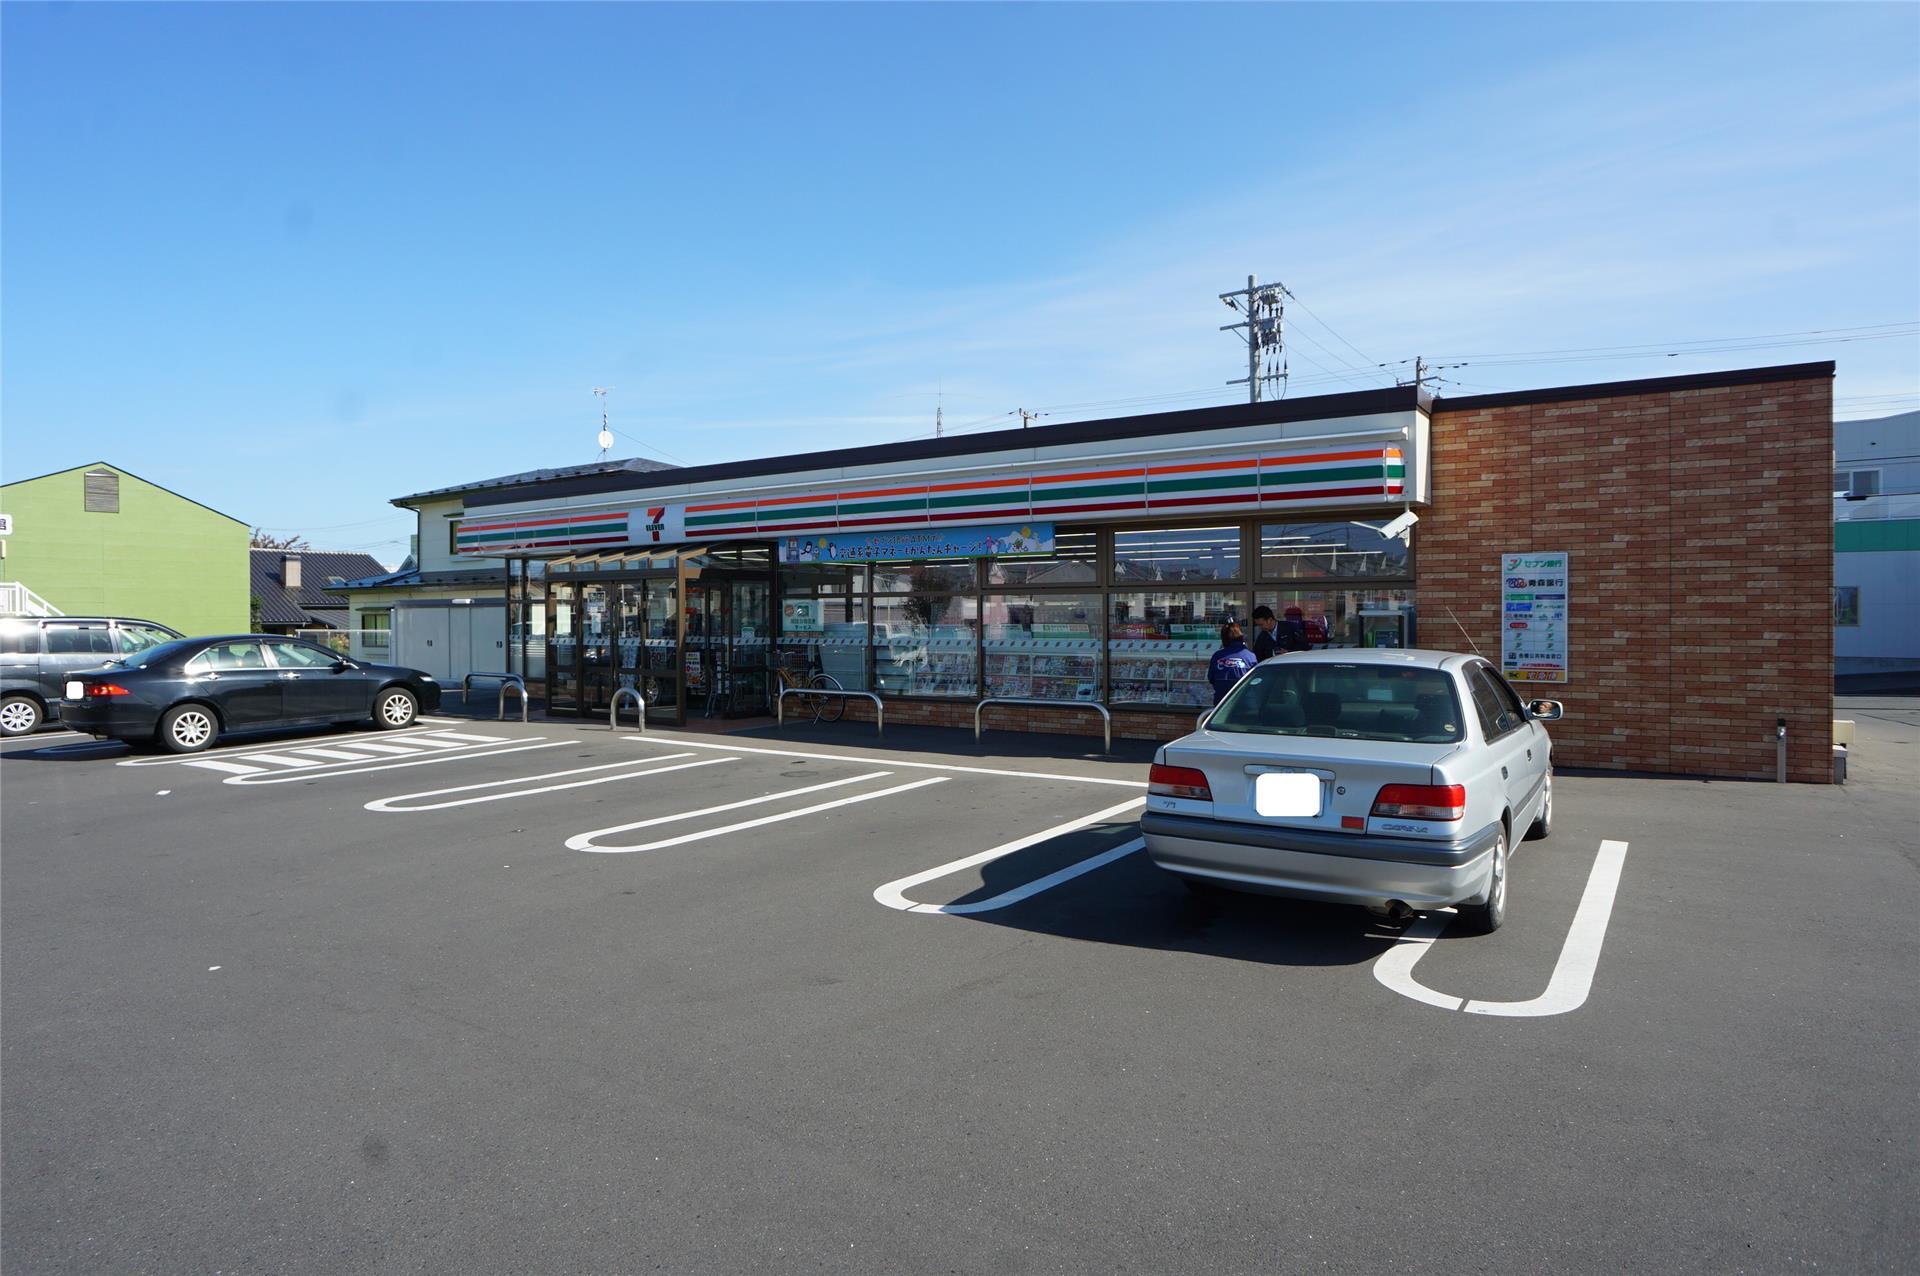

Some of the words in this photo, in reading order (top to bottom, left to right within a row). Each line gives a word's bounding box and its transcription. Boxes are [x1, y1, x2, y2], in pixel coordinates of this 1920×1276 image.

[647, 506, 665, 542] 7
[1524, 559, 1564, 568] セブン銀行
